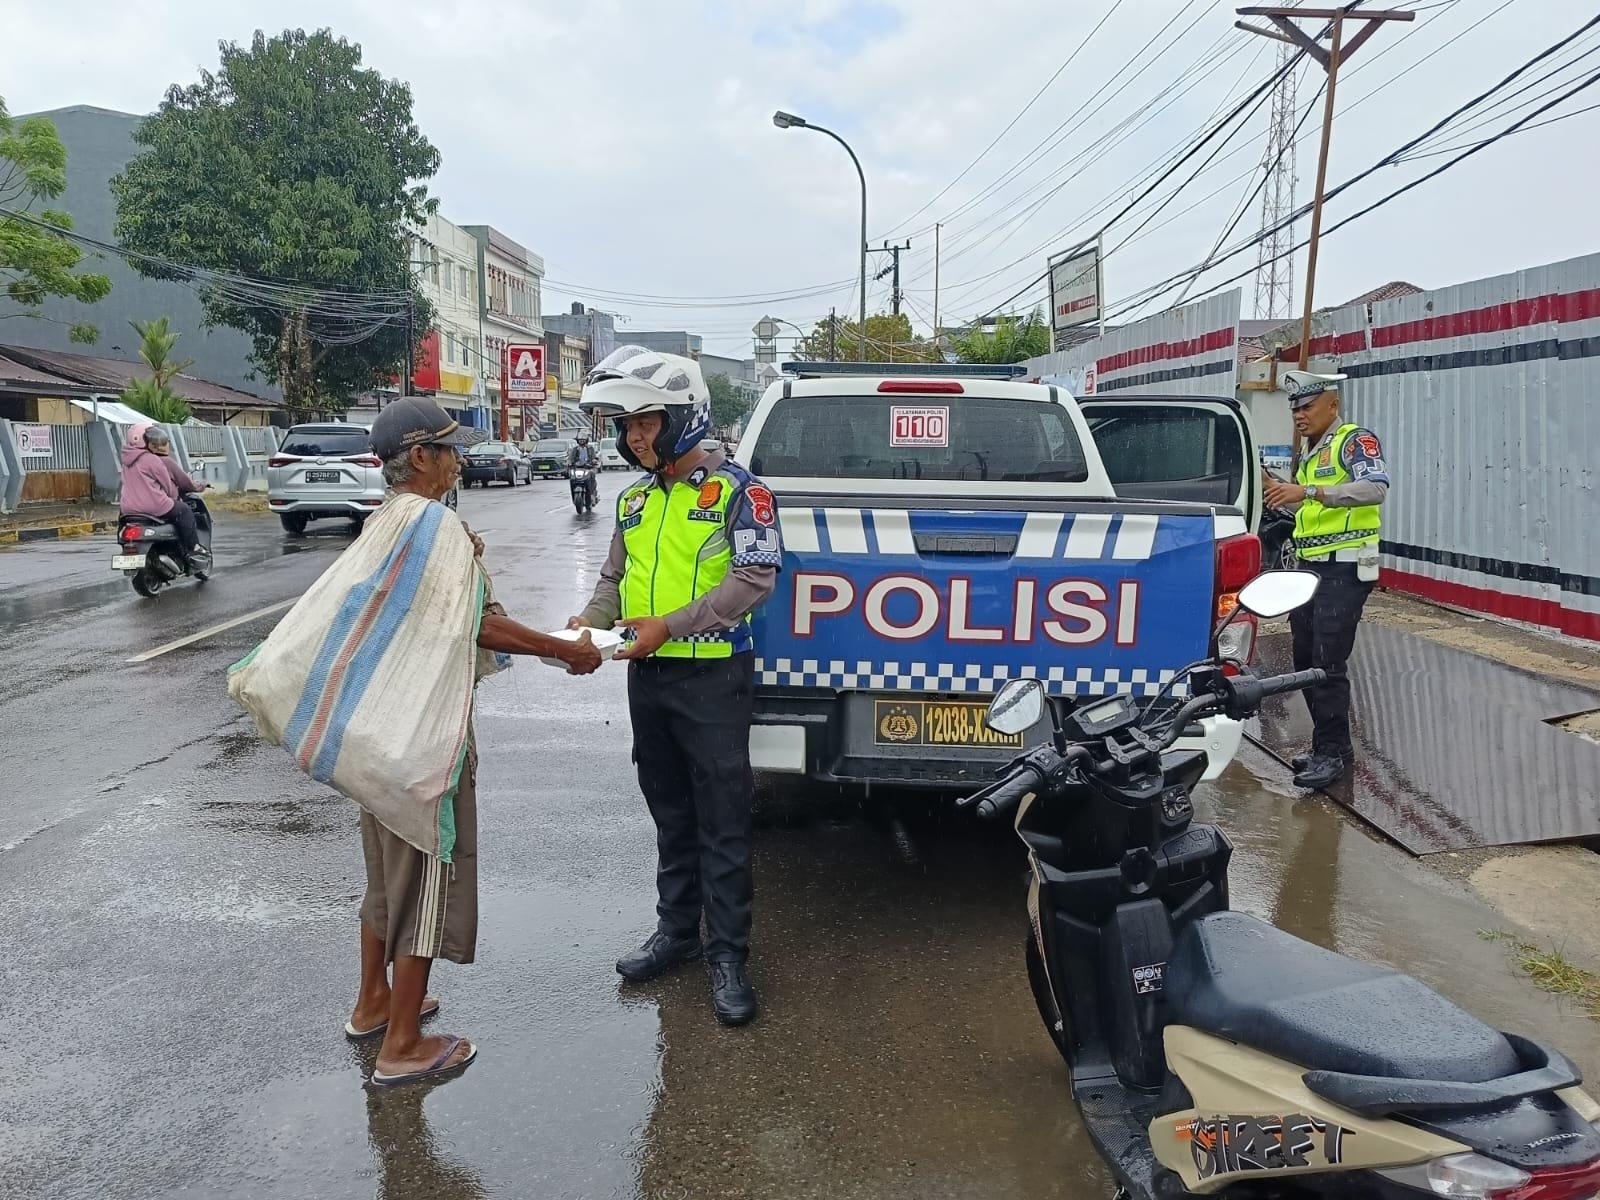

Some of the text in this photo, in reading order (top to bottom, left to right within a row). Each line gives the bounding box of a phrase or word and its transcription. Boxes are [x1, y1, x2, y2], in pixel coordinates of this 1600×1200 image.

[896, 415, 943, 438] 110
[1352, 458, 1385, 480] PJ
[689, 511, 721, 521] POLRI
[734, 527, 779, 553] PJ
[792, 572, 1139, 645] POLISI
[926, 706, 1018, 742] 12038-XX
[1191, 1114, 1356, 1181] STREET
